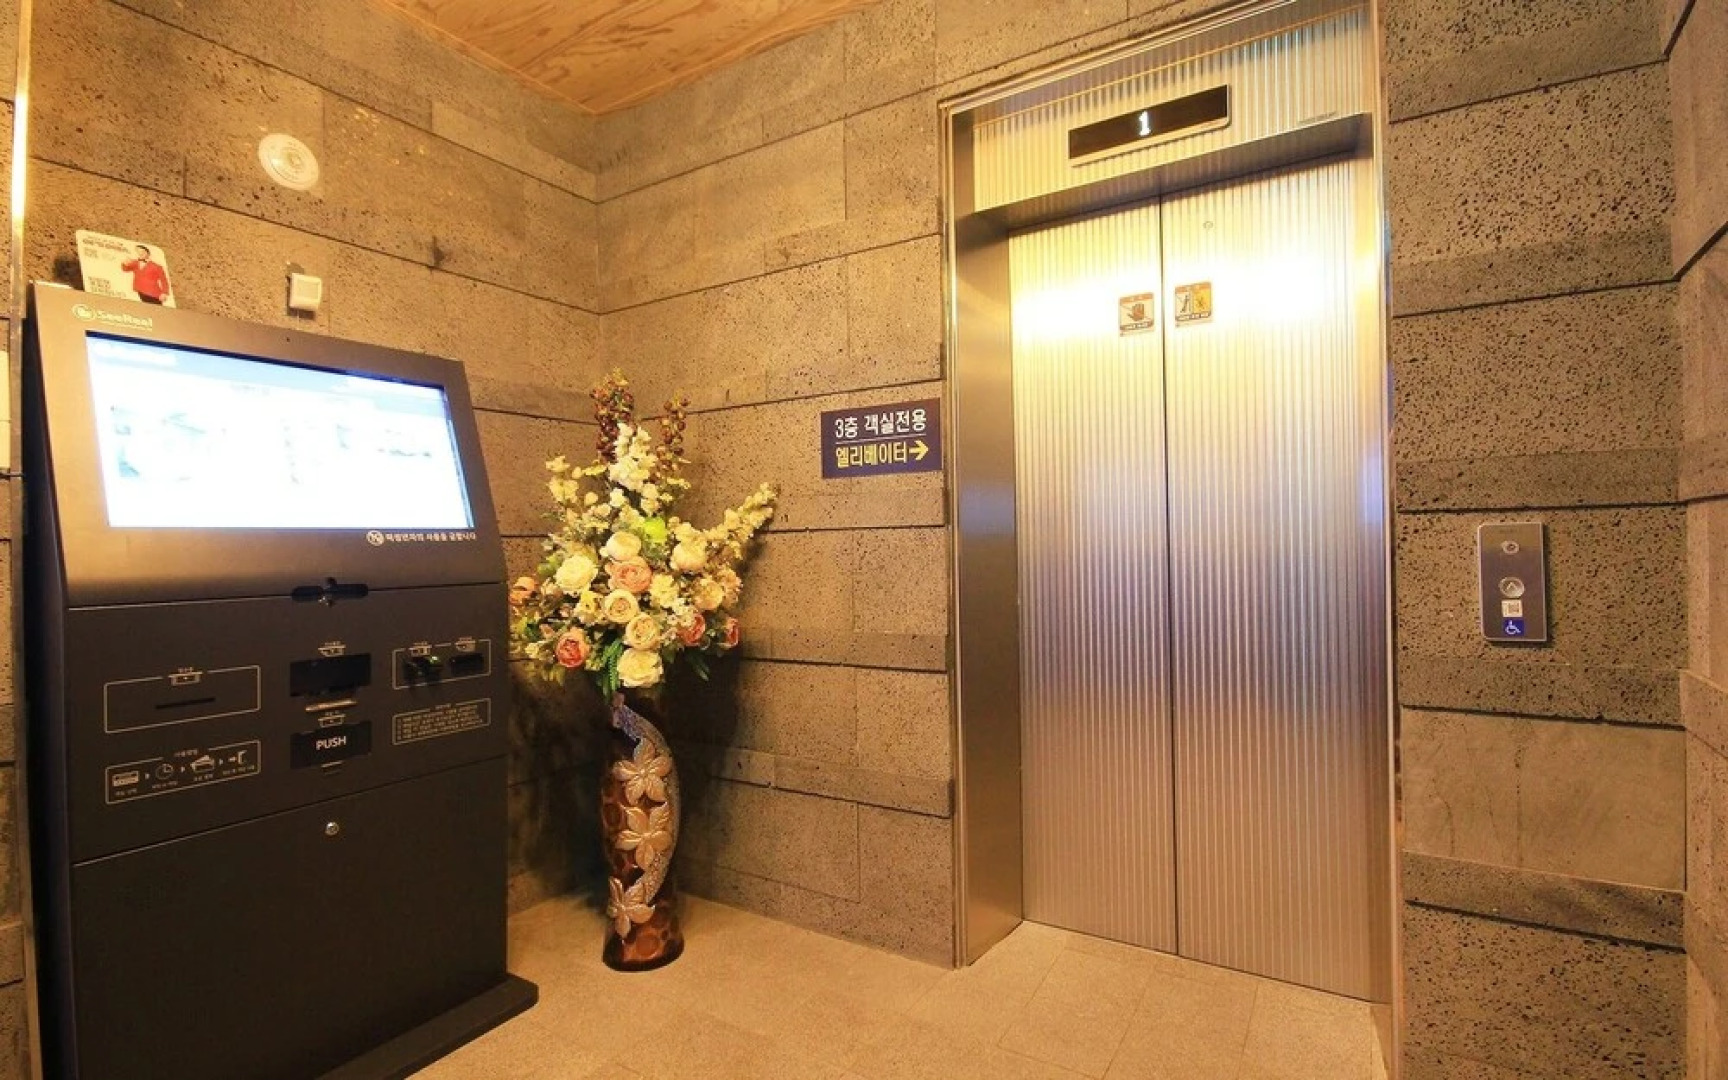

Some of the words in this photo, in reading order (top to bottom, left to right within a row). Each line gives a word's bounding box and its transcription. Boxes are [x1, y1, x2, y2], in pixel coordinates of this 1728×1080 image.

[1139, 110, 1151, 136] 1
[835, 416, 858, 438] 3층
[864, 409, 927, 435] 객실전용
[316, 736, 347, 751] PUSH
